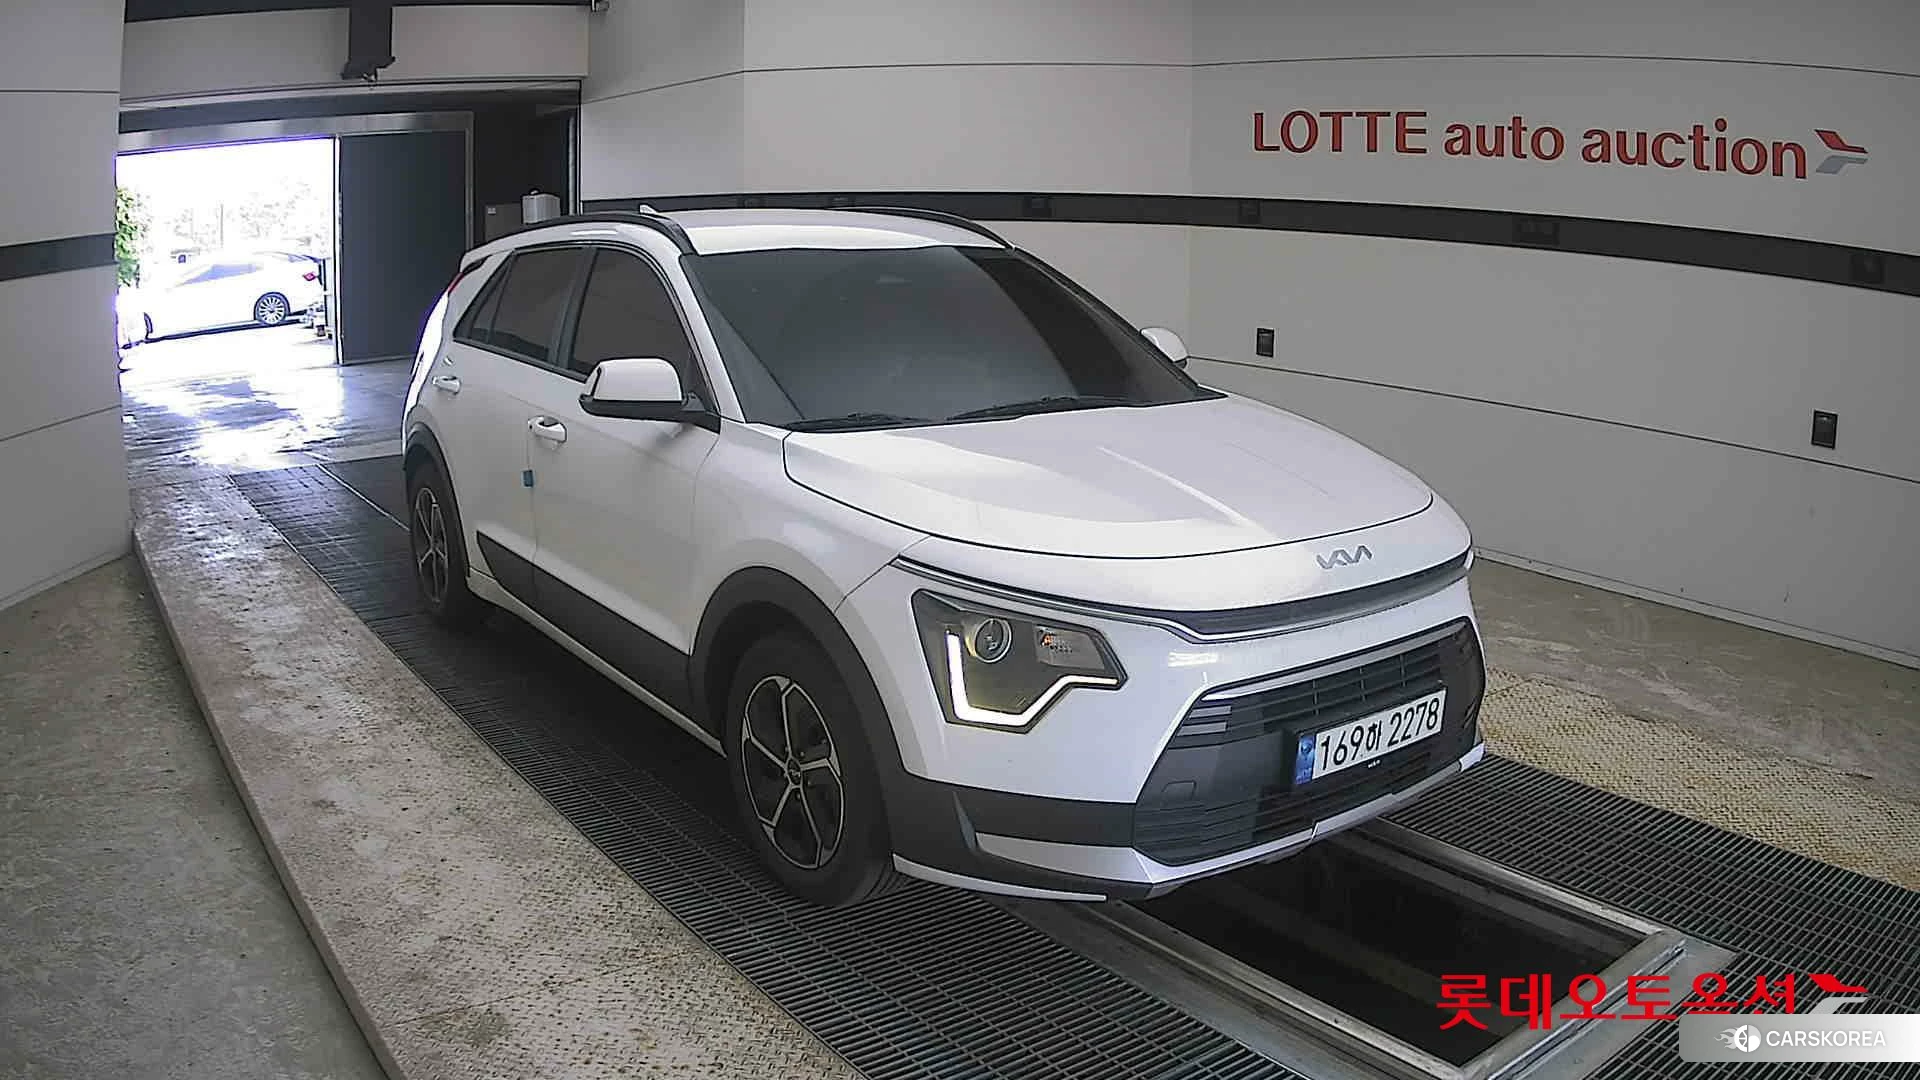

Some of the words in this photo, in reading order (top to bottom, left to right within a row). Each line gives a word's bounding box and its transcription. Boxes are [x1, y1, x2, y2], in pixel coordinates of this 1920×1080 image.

[1252, 110, 1428, 155] LOTTE
[1443, 115, 1566, 162] auto
[1580, 117, 1808, 180] auction
[1320, 719, 1382, 771] 169하
[1387, 697, 1440, 748] 2278
